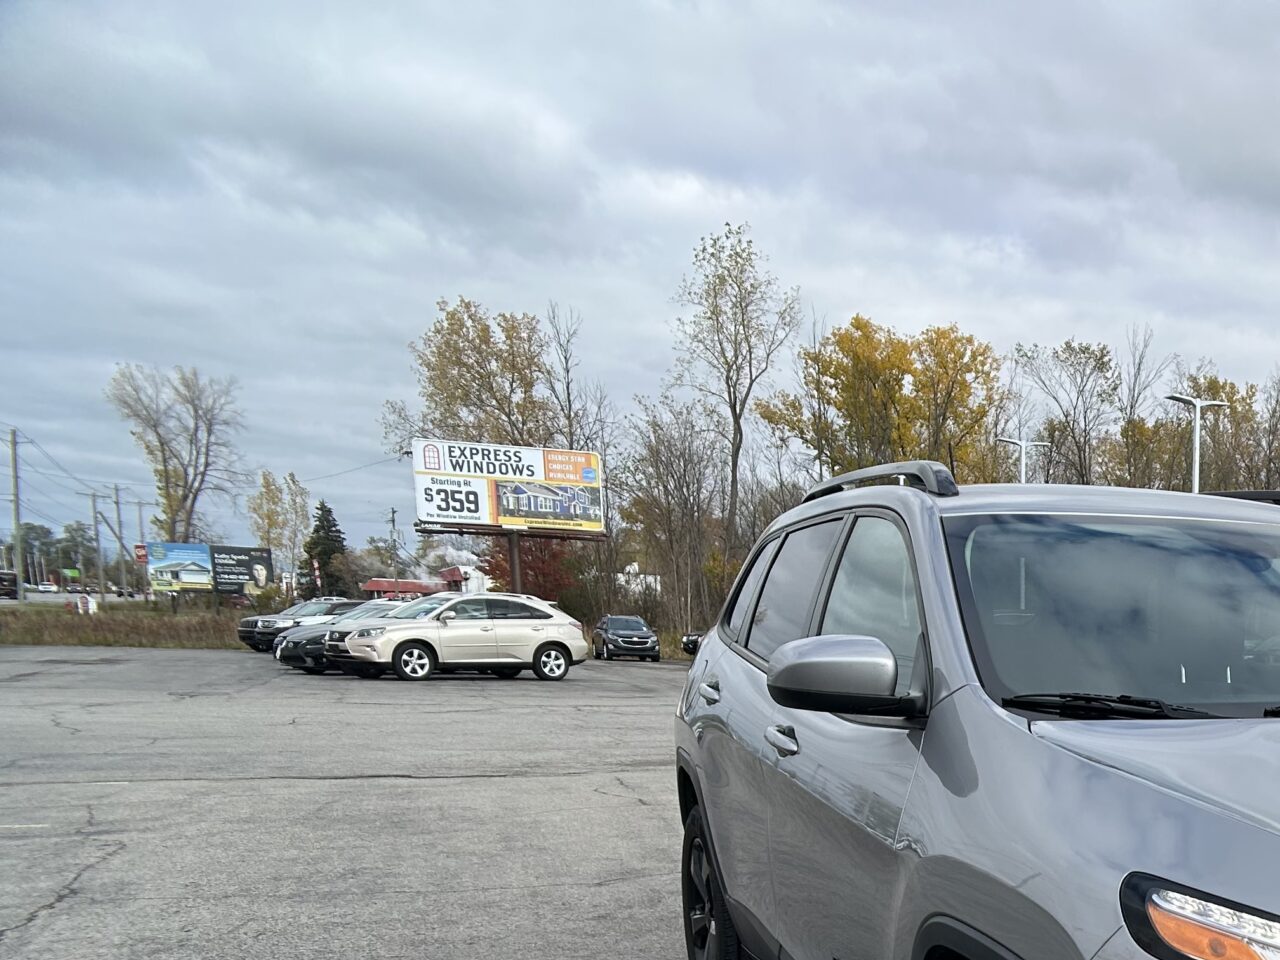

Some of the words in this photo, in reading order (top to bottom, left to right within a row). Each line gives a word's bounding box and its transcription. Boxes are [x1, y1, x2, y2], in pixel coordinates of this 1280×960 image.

[447, 445, 522, 463] EXPRESS
[450, 459, 535, 477] WINDOWS
[430, 477, 461, 488] Starting
[463, 479, 472, 487] At
